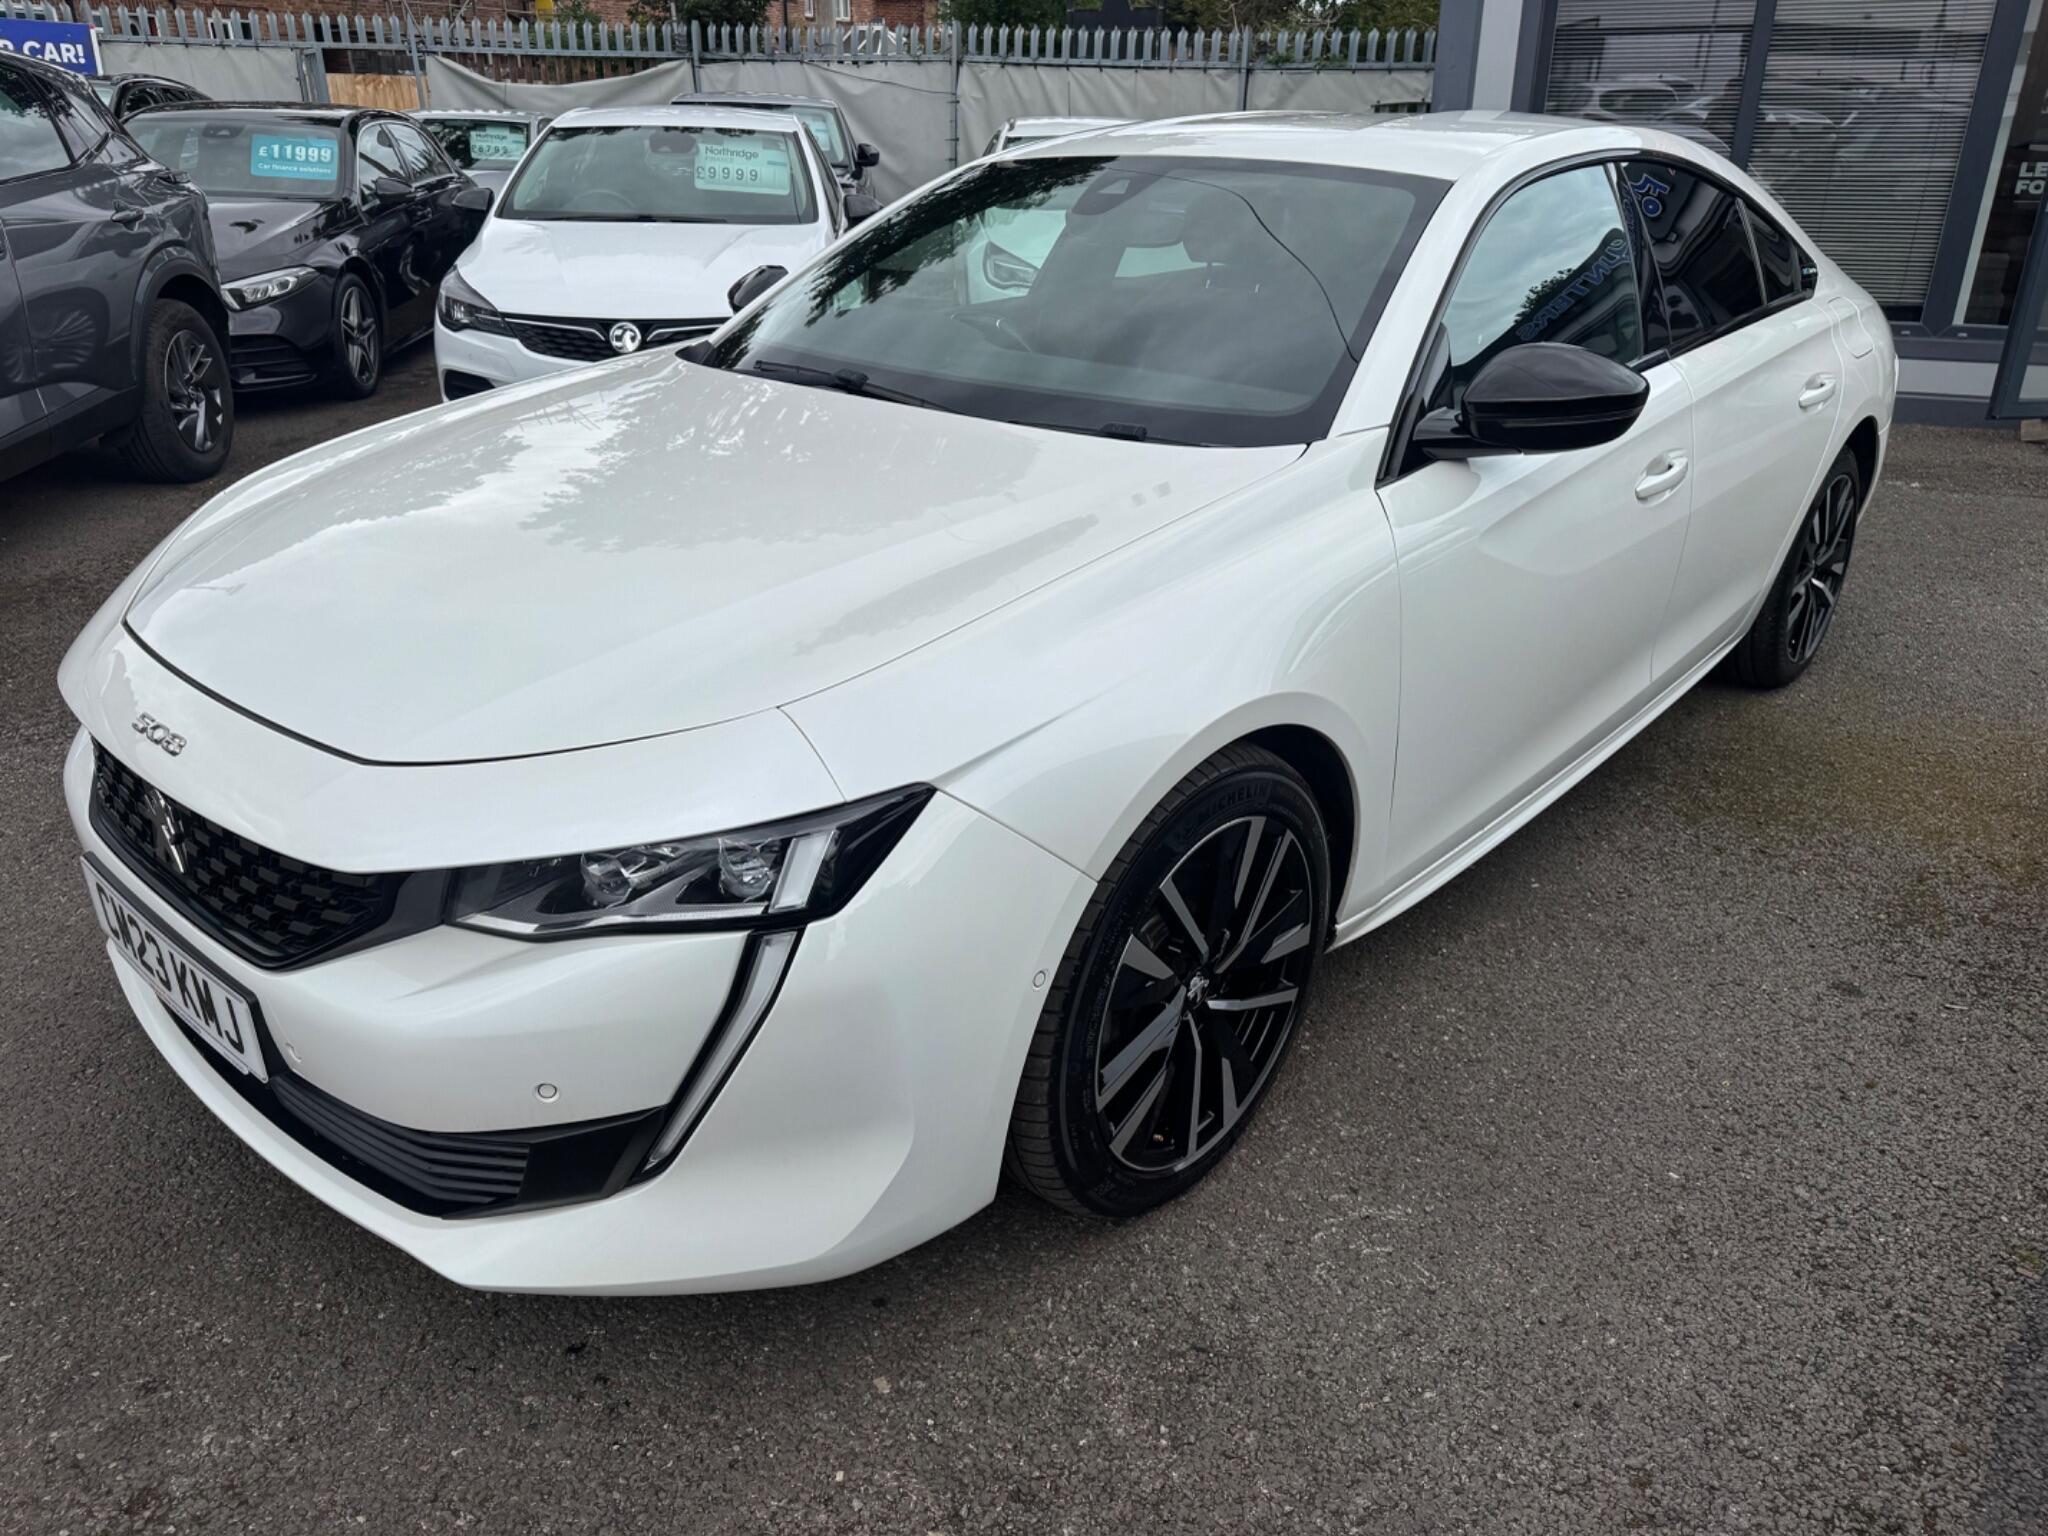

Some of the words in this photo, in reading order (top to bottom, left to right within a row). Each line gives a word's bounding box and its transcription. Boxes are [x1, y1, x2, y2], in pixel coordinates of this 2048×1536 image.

[22, 40, 86, 64] CAR!
[704, 145, 759, 160] Northridge
[696, 166, 758, 181] £9999
[131, 711, 187, 757] 508
[168, 951, 245, 1055] KMJ
